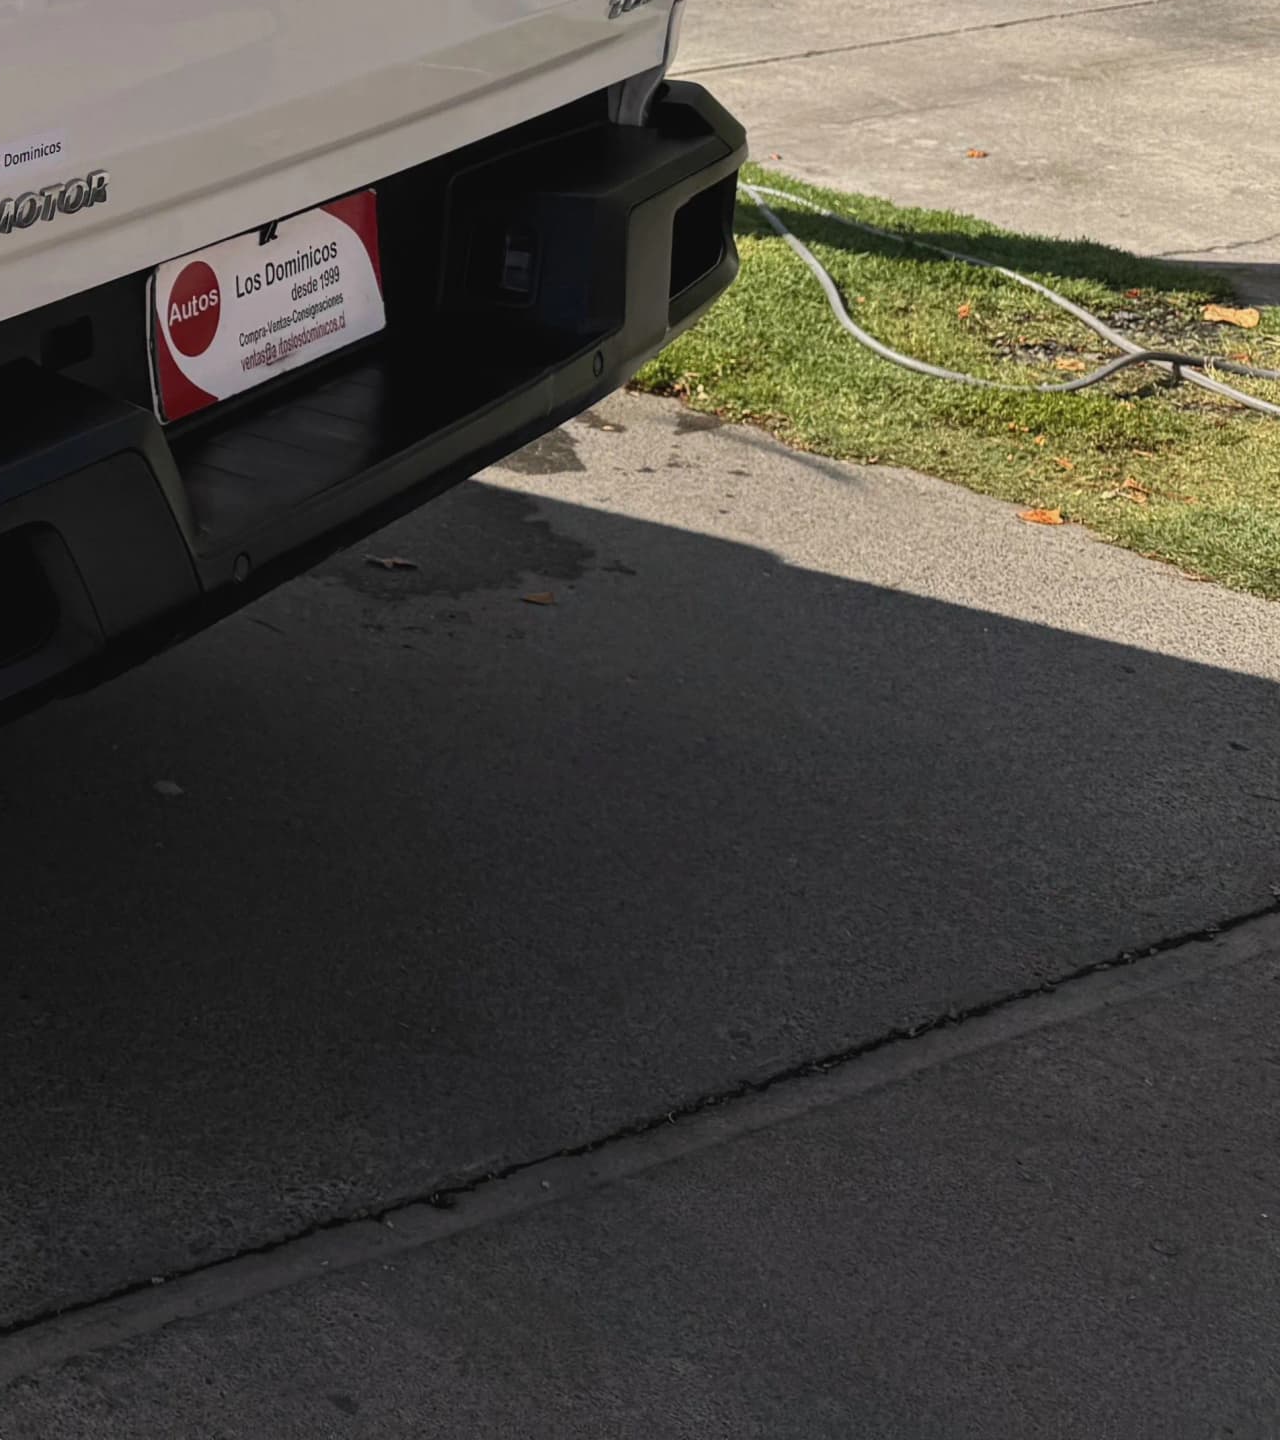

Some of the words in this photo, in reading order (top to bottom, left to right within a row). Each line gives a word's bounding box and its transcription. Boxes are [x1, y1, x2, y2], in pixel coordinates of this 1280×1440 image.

[3, 140, 62, 168] Dominicos
[235, 274, 262, 299] Los
[265, 241, 338, 286] Dominicos
[291, 275, 319, 301] desde
[319, 265, 341, 290] 1999
[168, 288, 219, 327] Autos
